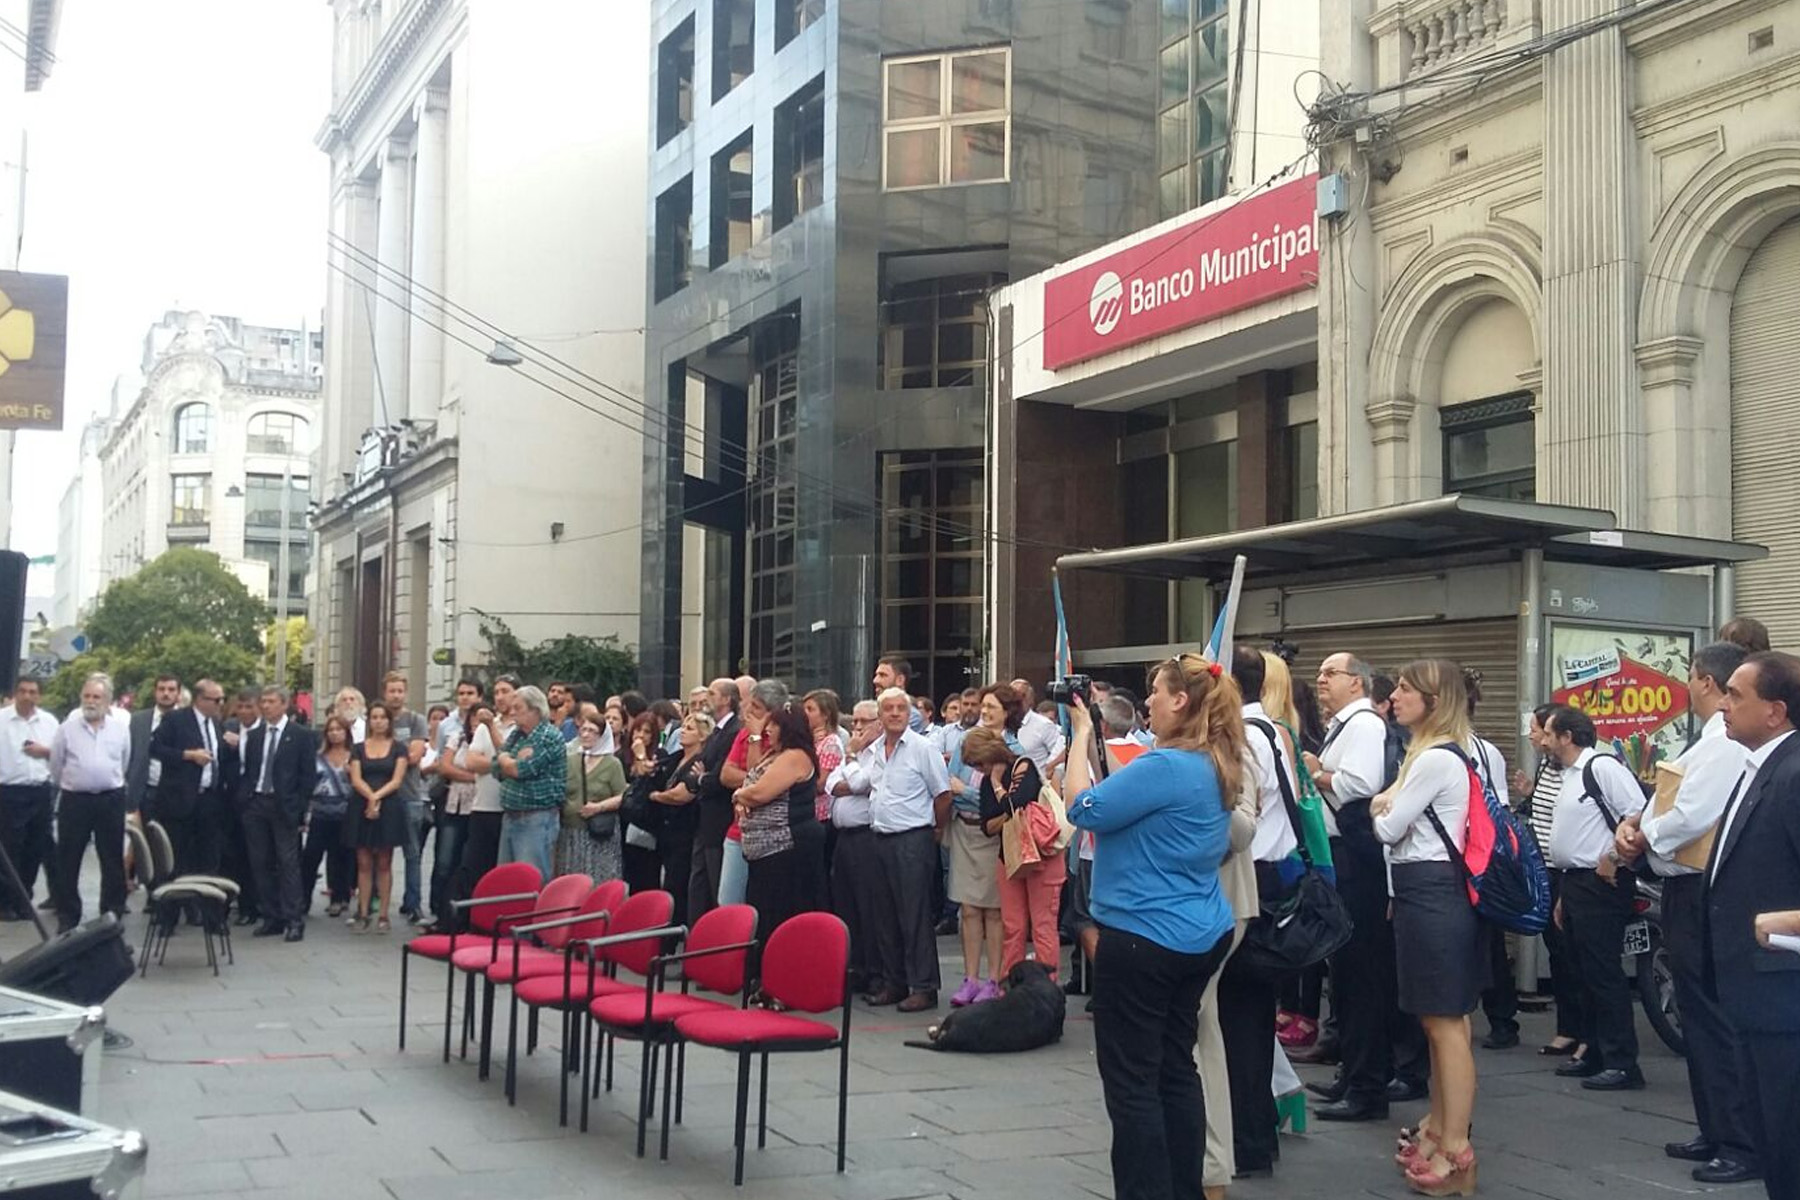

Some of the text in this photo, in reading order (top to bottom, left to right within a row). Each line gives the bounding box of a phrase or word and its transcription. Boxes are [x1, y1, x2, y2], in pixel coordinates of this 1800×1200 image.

[1130, 208, 1319, 316] Banco Municipal
[30, 660, 52, 675] 24
[1577, 654, 1607, 669] CAPITAL
